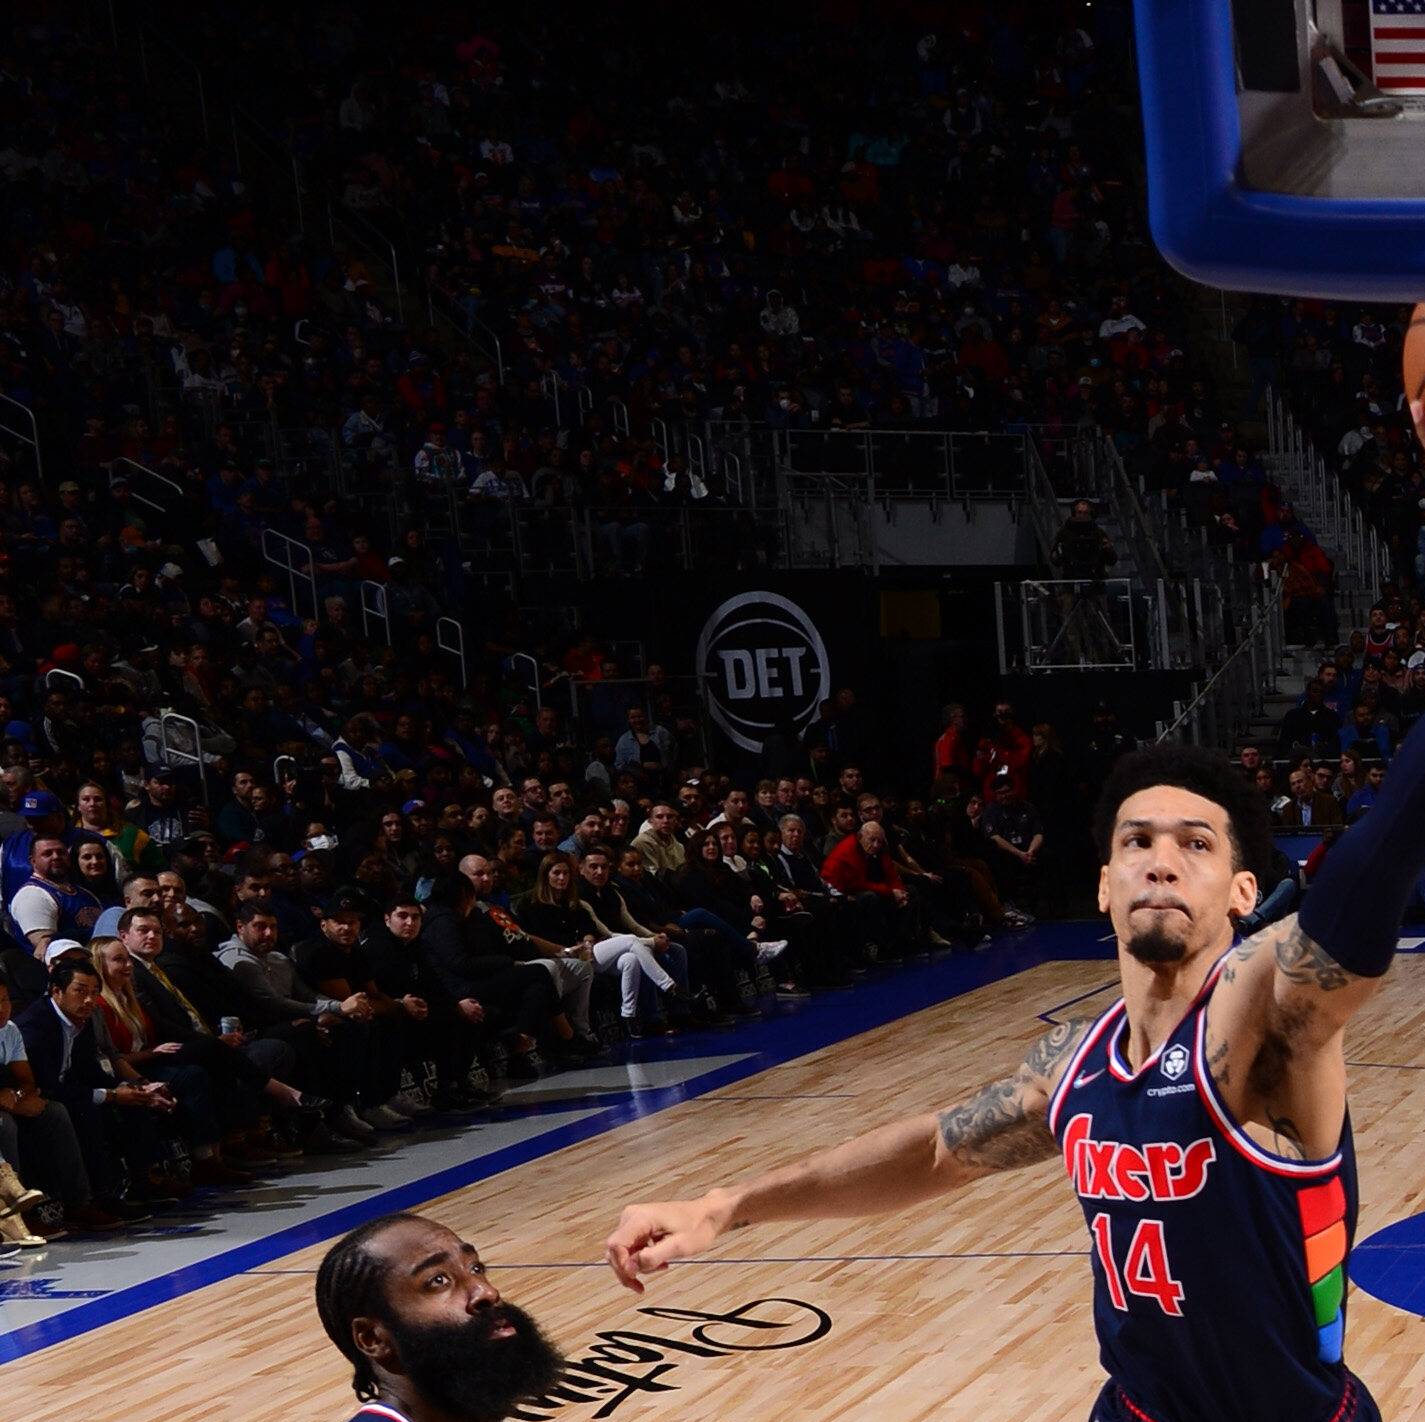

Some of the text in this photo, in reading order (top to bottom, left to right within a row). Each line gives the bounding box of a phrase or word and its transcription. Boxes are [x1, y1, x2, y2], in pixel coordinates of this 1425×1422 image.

[717, 647, 807, 700] DET
[1146, 1083, 1196, 1098] crypto.com
[1091, 1212, 1185, 1317] 14
